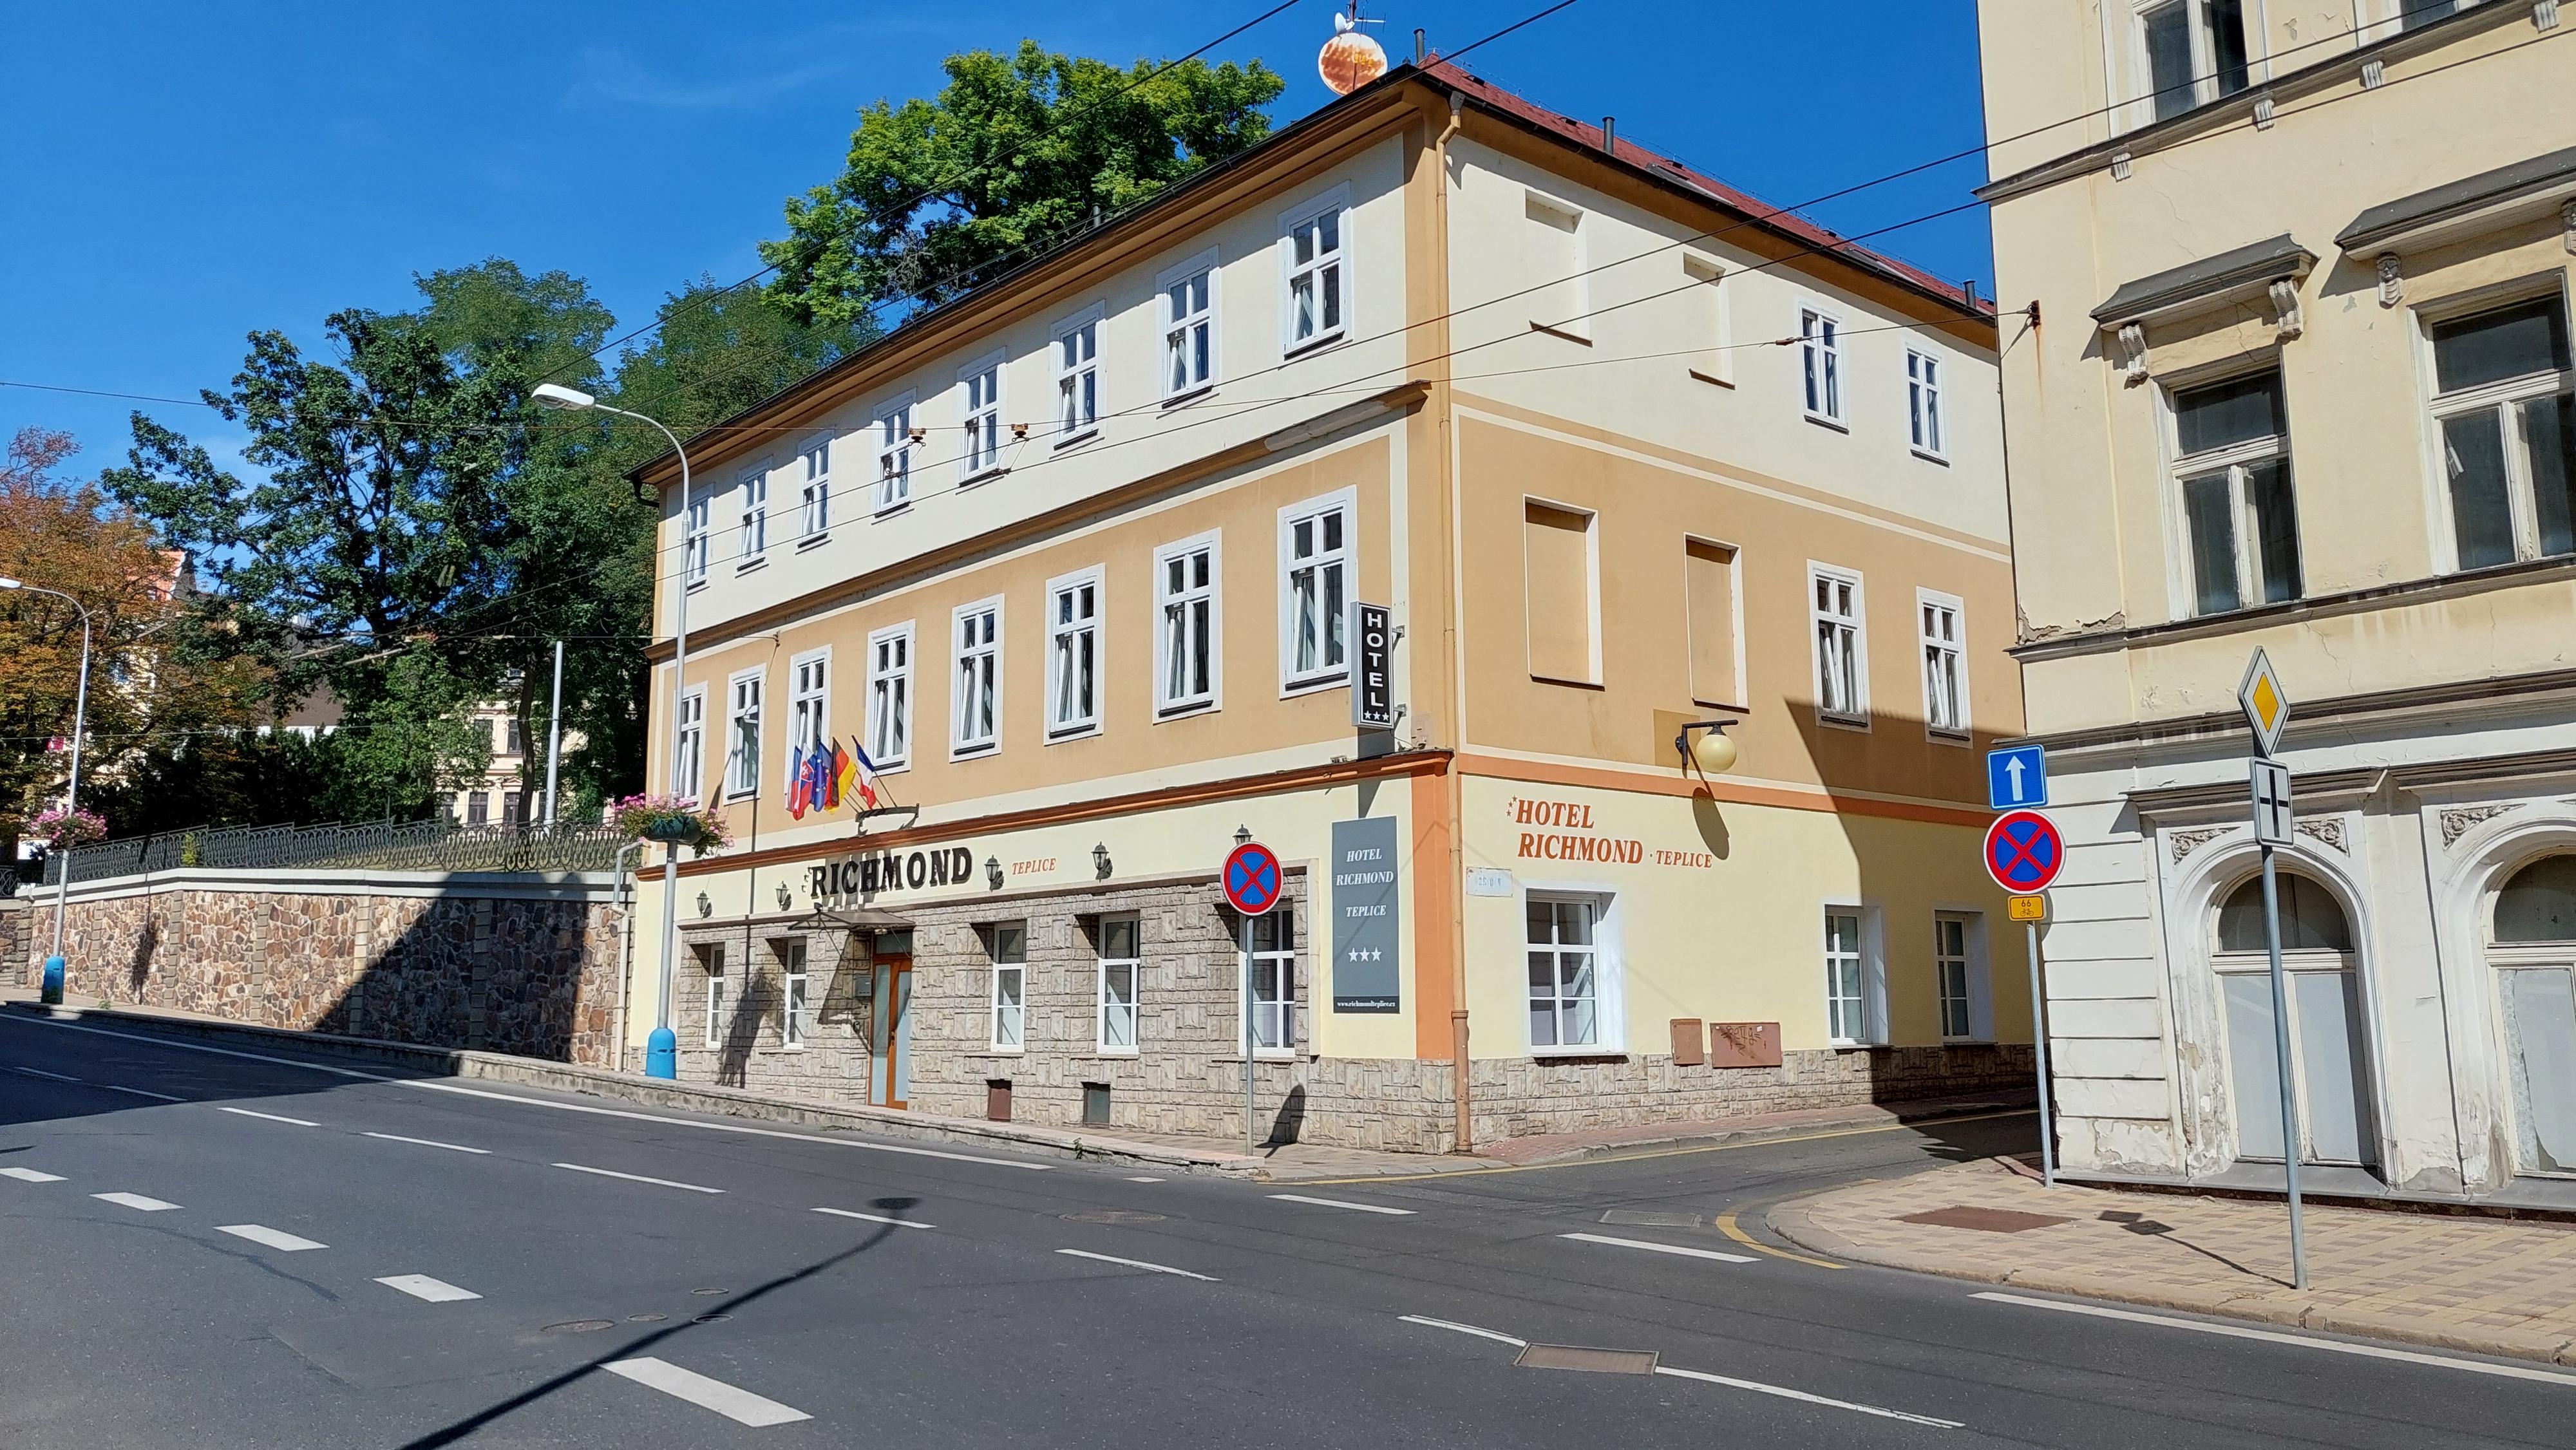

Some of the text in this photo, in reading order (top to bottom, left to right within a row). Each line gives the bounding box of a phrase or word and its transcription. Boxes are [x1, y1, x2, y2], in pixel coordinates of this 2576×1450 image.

[1367, 612, 1384, 707] HOTEL
[1515, 800, 1595, 829] HOTEL
[1346, 848, 1383, 862] HOTEL
[1517, 833, 1713, 868] RICHMOND TEPLICE
[810, 847, 1056, 898] RICHMOND TEPLICE
[1336, 871, 1394, 886] RICHMOND
[1346, 905, 1387, 918] TEPLICE
[2021, 899, 2031, 907] 66
